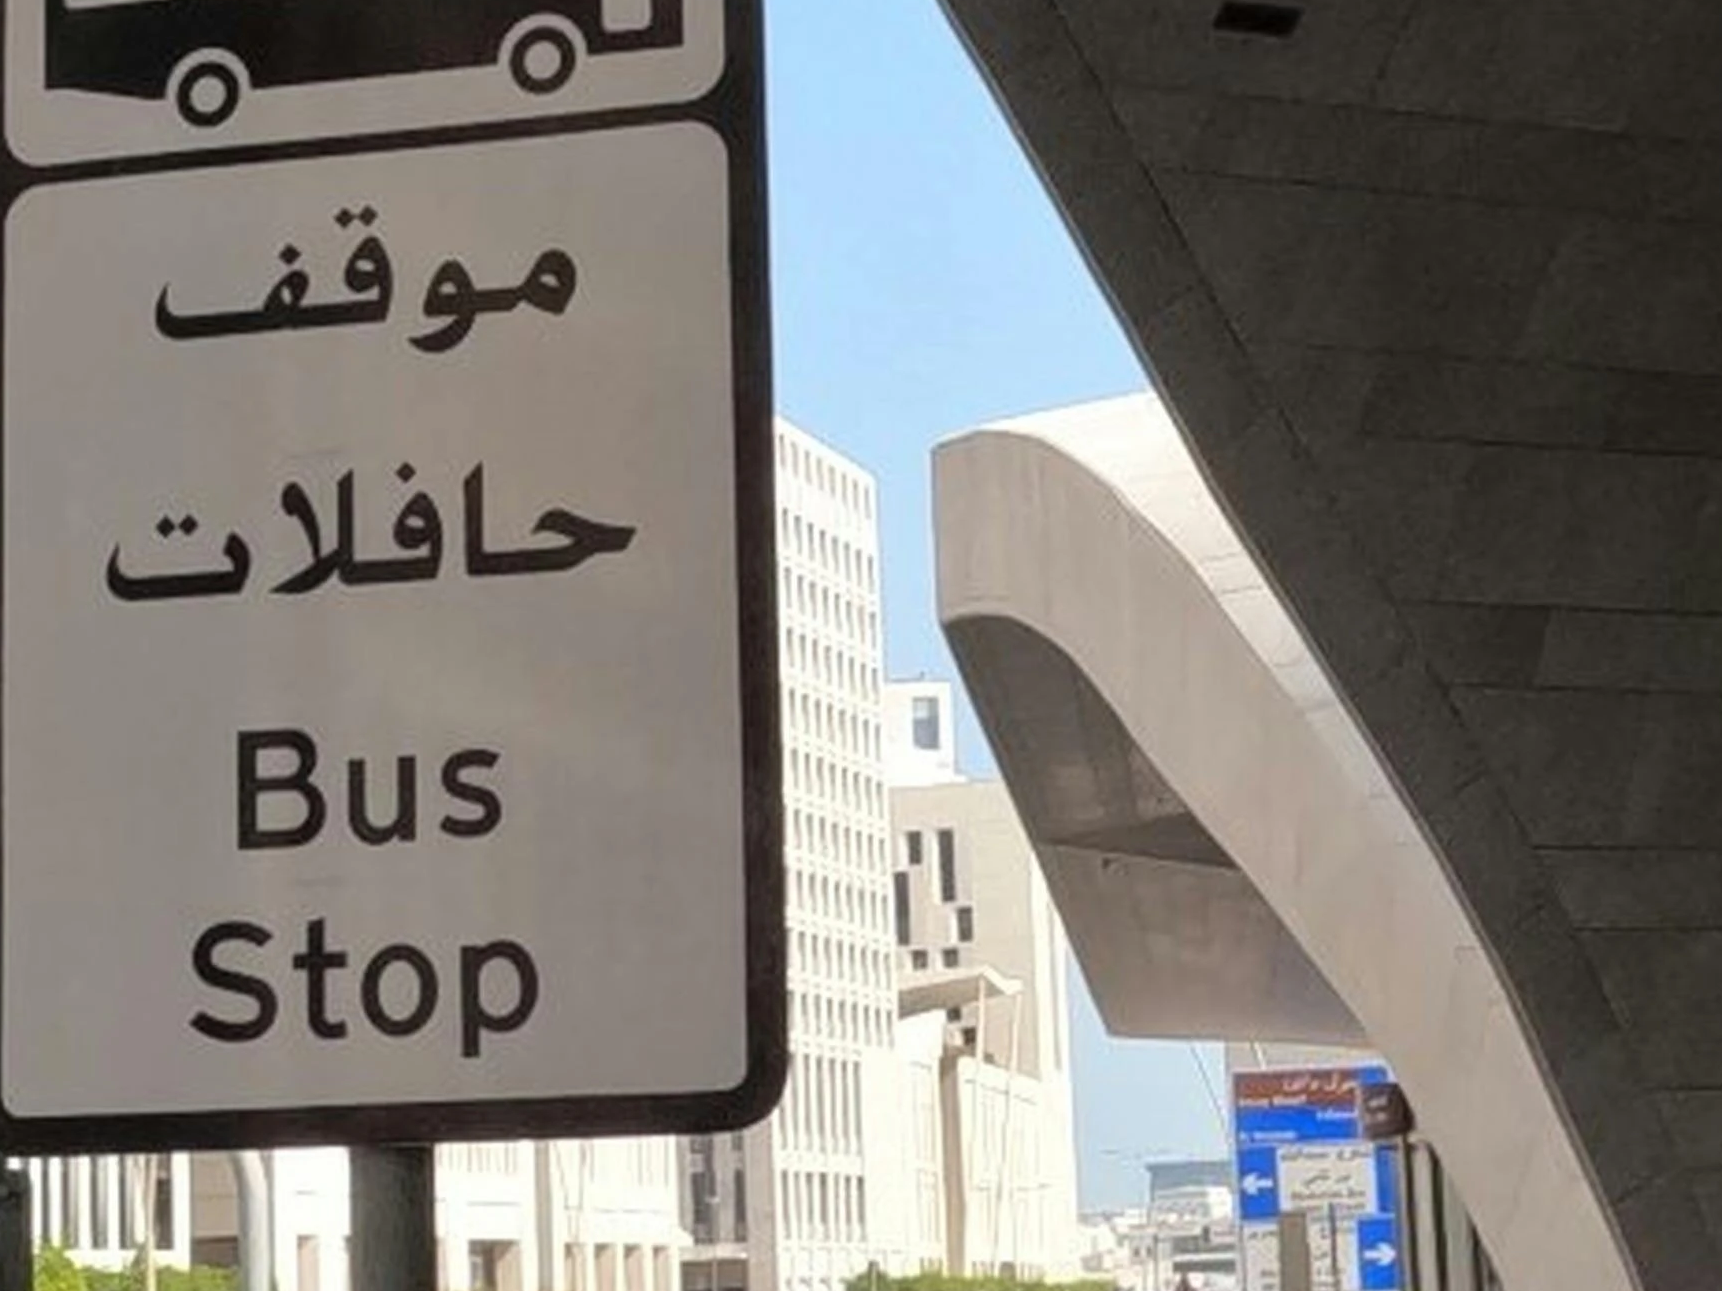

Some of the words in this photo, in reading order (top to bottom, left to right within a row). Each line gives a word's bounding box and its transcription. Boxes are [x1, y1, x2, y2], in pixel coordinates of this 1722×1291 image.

[154, 206, 576, 353] موقف
[106, 462, 635, 601] حافلات
[236, 728, 501, 850] Bus
[189, 917, 538, 1058] Stop
